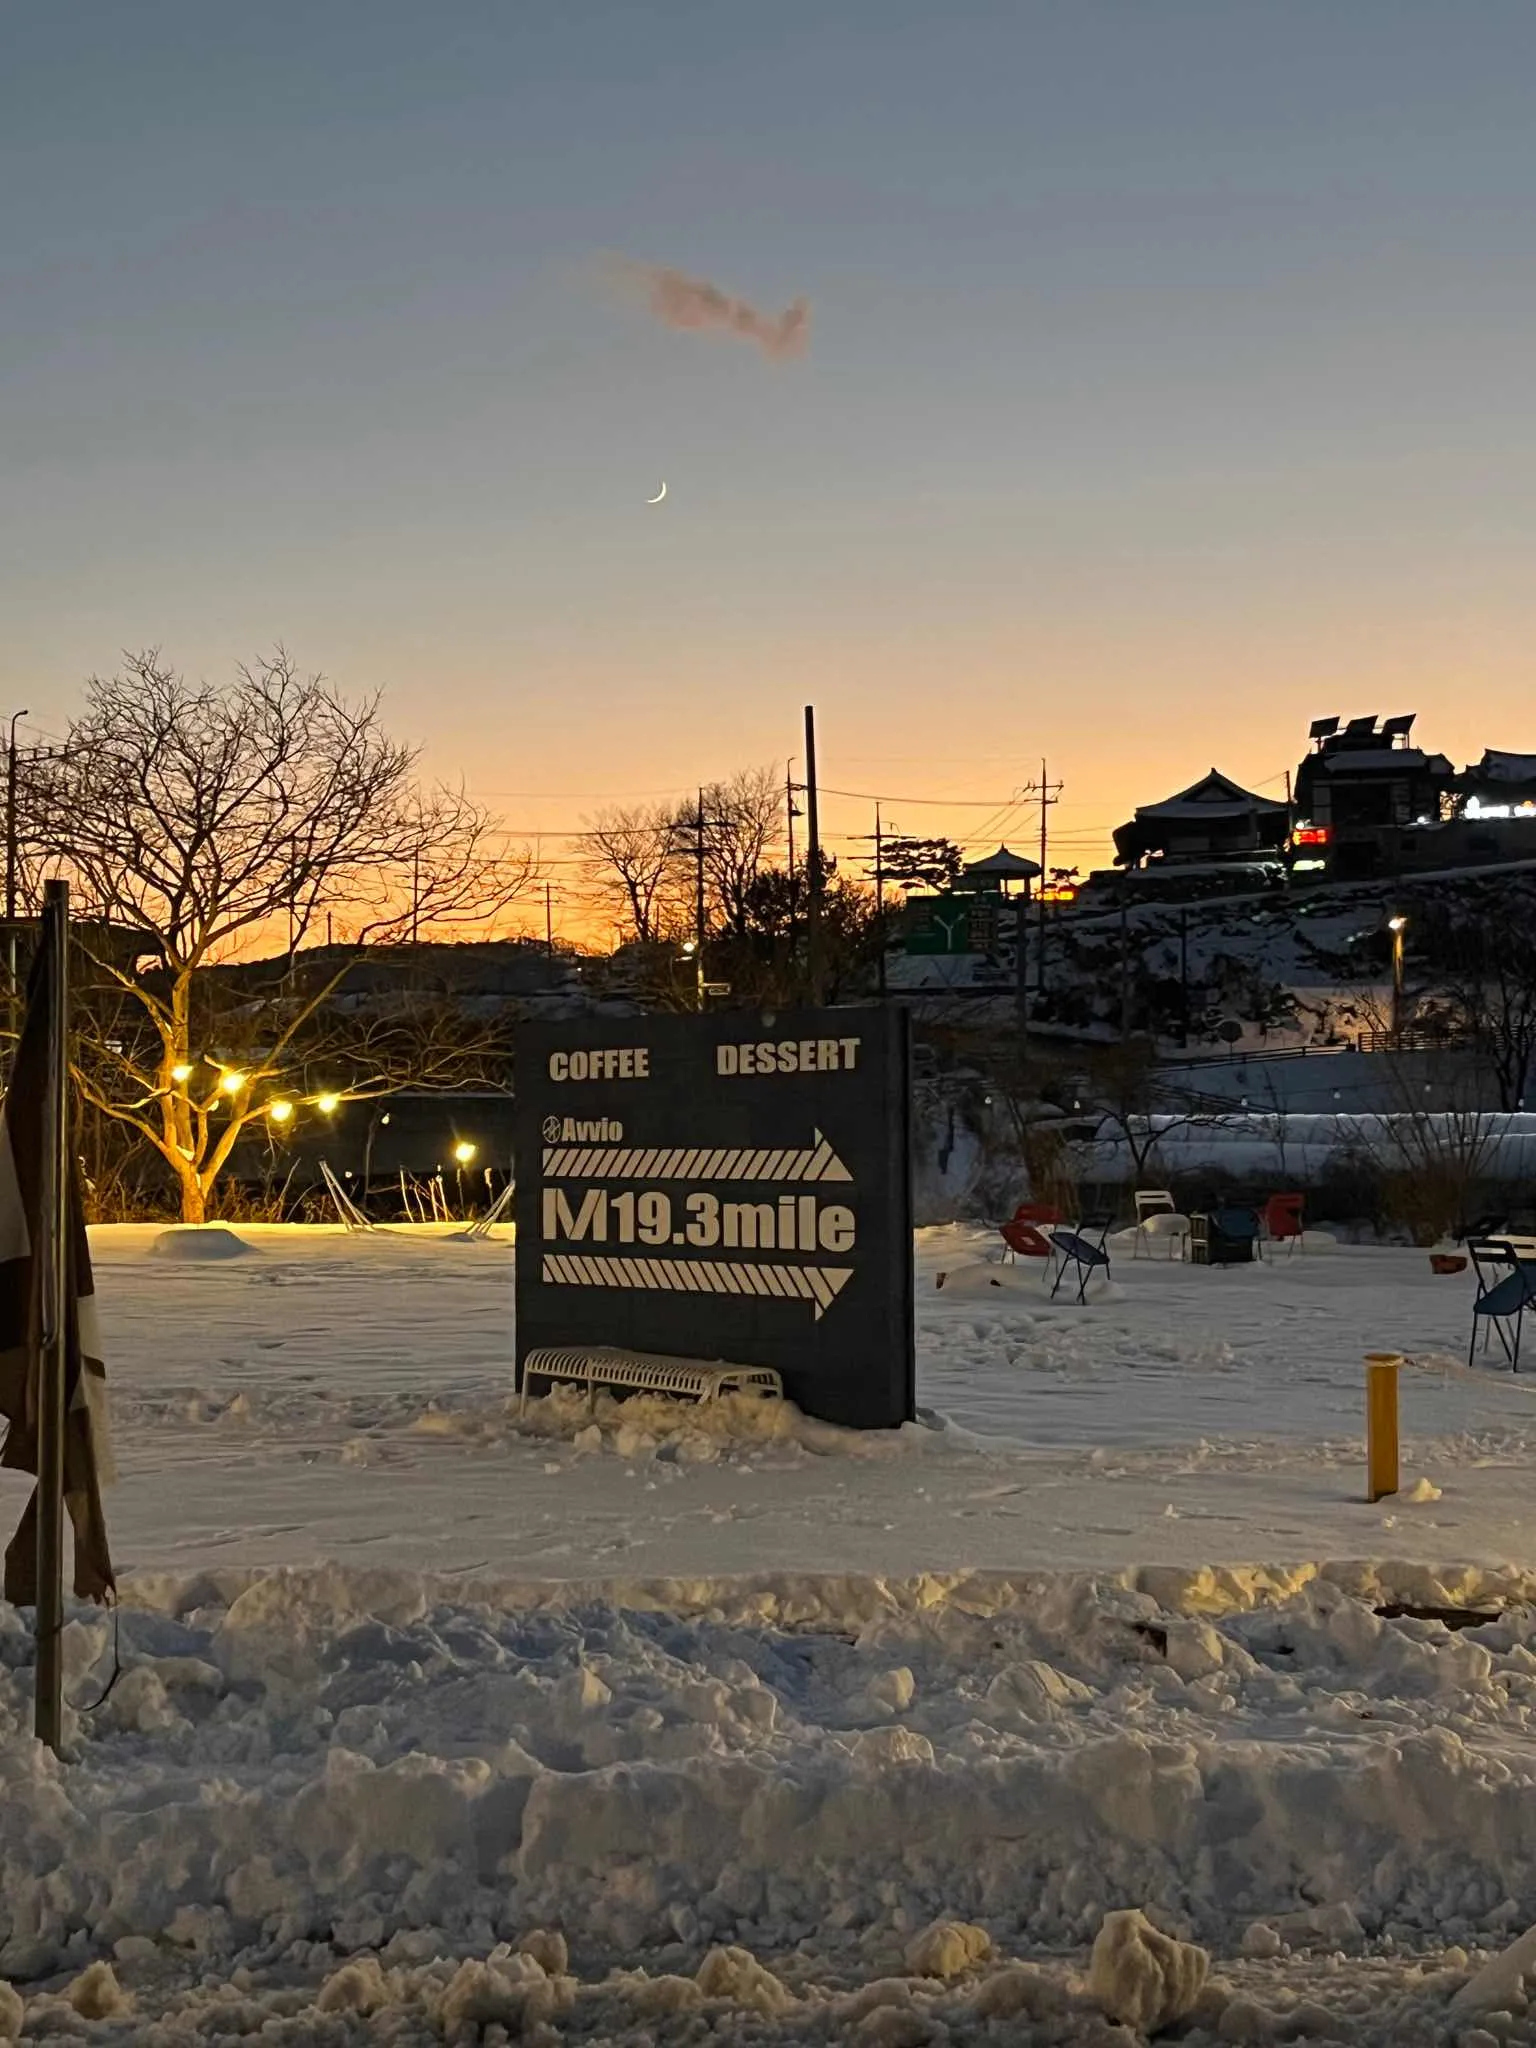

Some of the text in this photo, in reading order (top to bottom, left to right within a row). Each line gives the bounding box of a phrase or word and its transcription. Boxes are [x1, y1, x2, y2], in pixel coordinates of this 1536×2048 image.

[549, 1048, 649, 1081] COFFEE
[716, 1038, 861, 1075] DESSERT
[561, 1117, 623, 1142] Avvio
